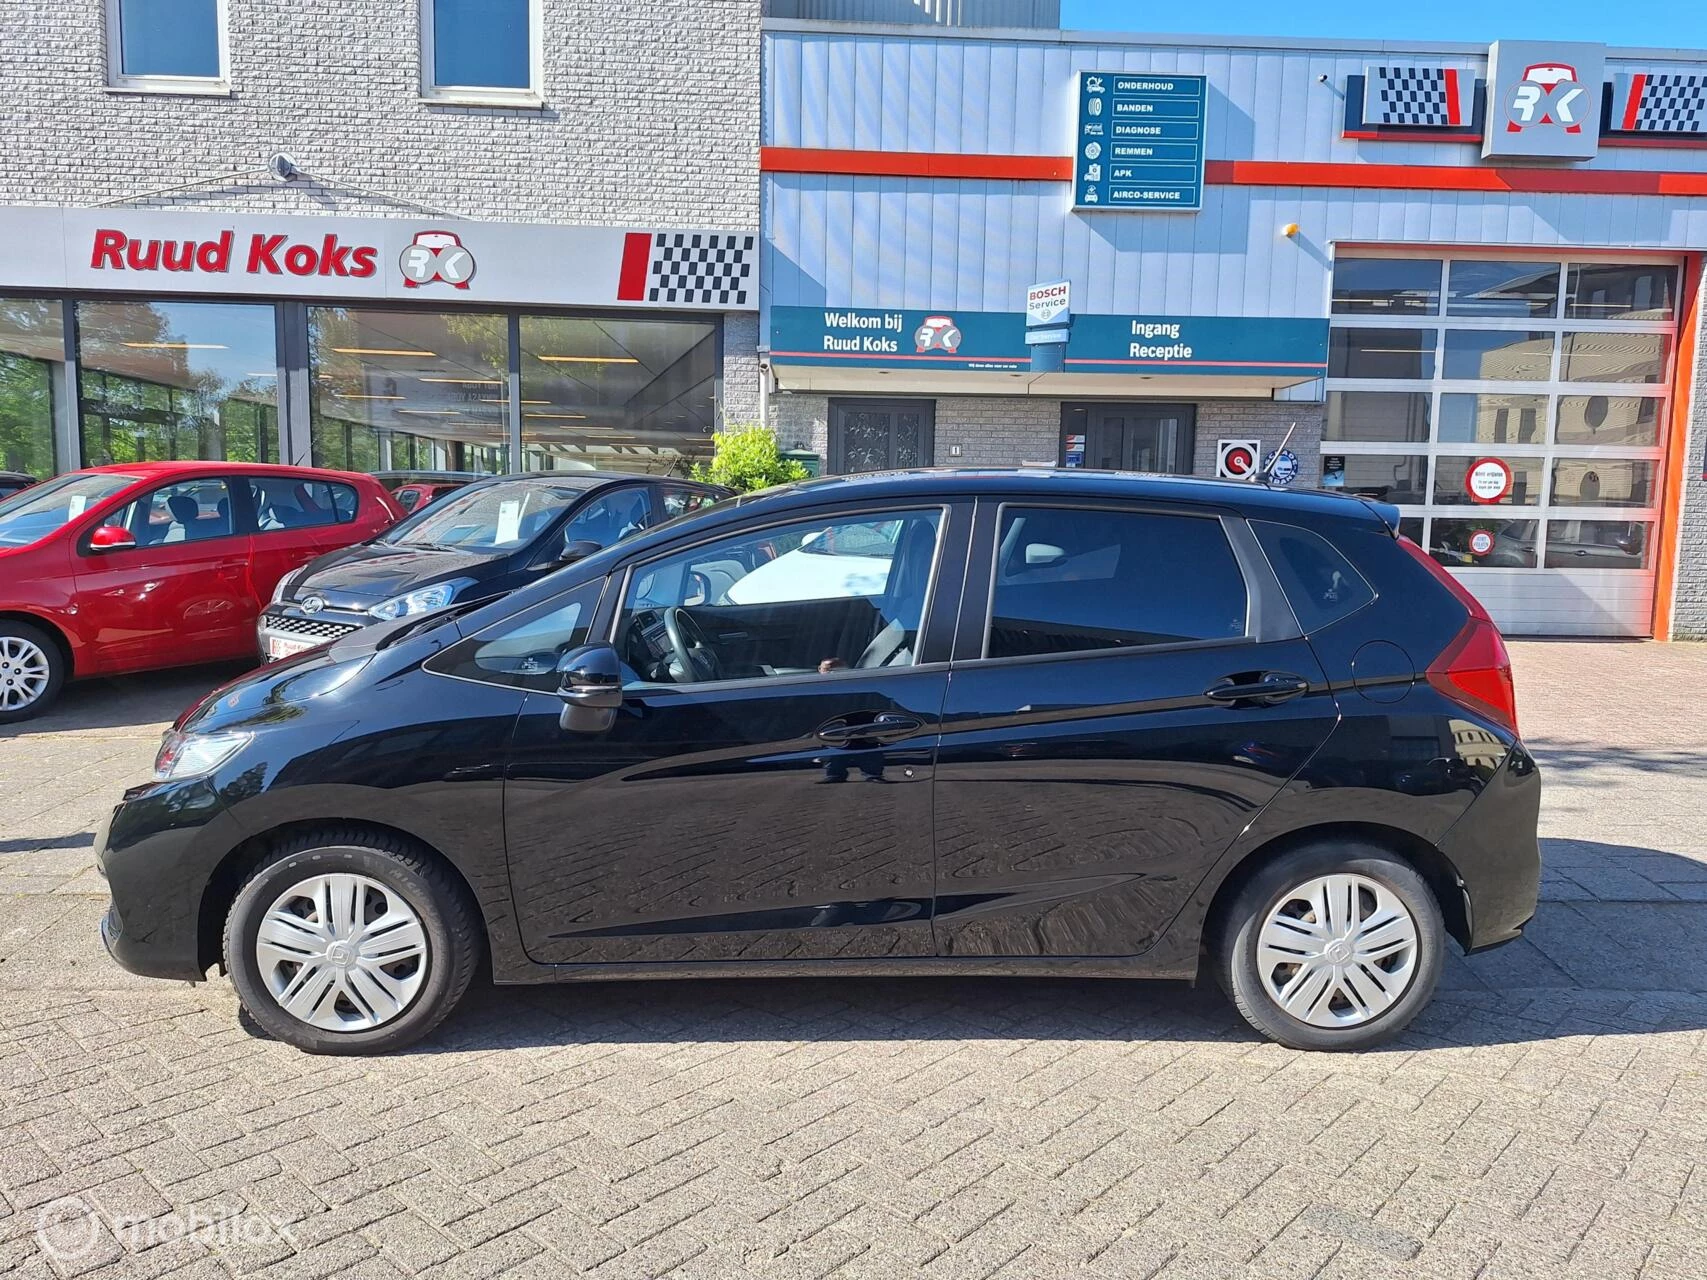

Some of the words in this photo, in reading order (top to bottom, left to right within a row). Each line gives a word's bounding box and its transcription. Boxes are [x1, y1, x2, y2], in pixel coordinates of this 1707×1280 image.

[1117, 82, 1174, 90] ONDERHOUD
[1116, 104, 1154, 112] BANDEN
[1115, 127, 1162, 135] DIAGNOSE
[1114, 147, 1153, 155] REMMEN
[1113, 169, 1132, 177] APK
[1113, 191, 1181, 199] AIRCO-SERVICE
[90, 228, 234, 273] Ruud
[246, 233, 378, 278] Koks
[1029, 286, 1067, 301] BOSCH
[1029, 298, 1066, 310] Service
[824, 312, 884, 329] Welkom
[884, 313, 903, 332] bij
[1131, 320, 1180, 338] Ingang
[823, 335, 860, 351] Ruud
[863, 336, 898, 352] Koks
[1130, 342, 1193, 360] Receptie
